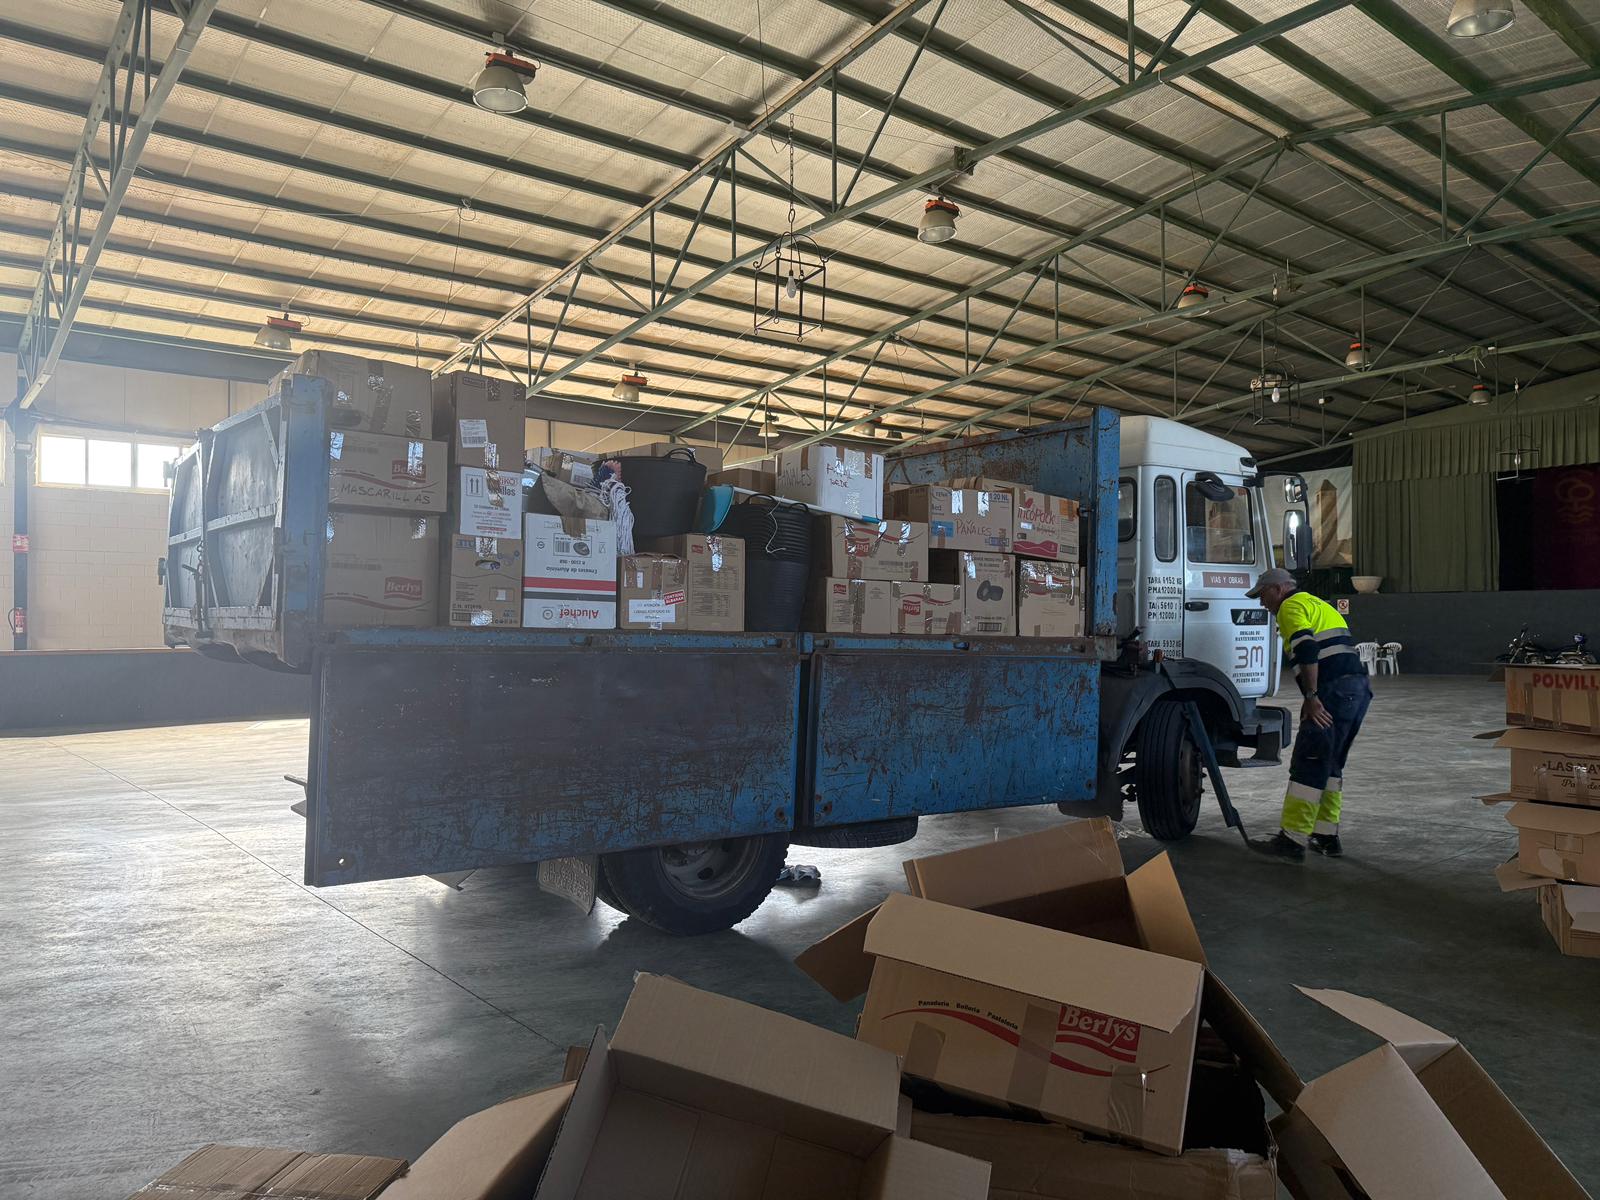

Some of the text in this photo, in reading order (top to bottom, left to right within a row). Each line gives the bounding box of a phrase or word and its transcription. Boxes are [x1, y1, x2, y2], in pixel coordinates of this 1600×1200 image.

[1147, 576, 1161, 584] TARA
[559, 607, 599, 619] Aluchef
[1532, 672, 1600, 691] POLVILL
[1060, 1005, 1137, 1047] Berlys
